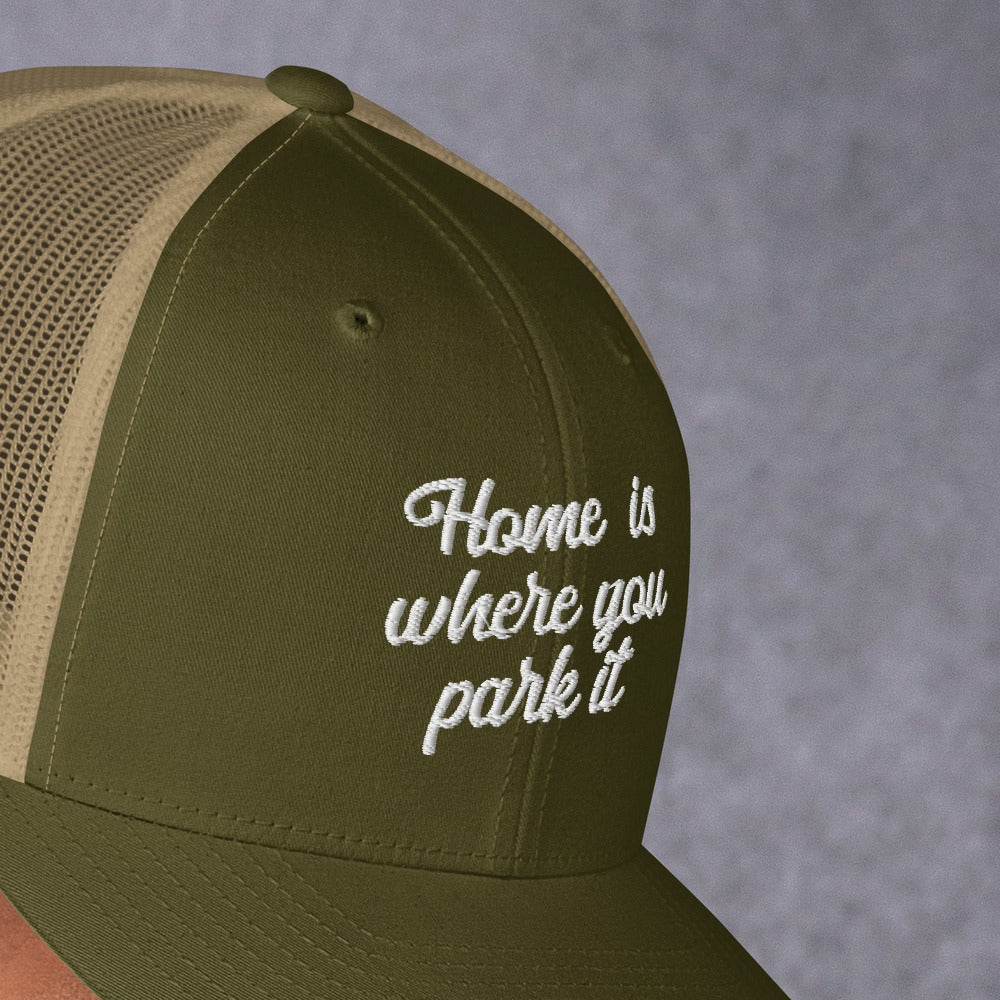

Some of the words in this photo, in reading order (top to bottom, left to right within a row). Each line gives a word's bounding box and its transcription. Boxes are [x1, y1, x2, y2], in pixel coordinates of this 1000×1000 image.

[403, 477, 608, 558] Home
[628, 475, 656, 539] is
[384, 569, 583, 646] where
[592, 568, 668, 654] you
[421, 644, 582, 756] park
[588, 635, 635, 714] it
